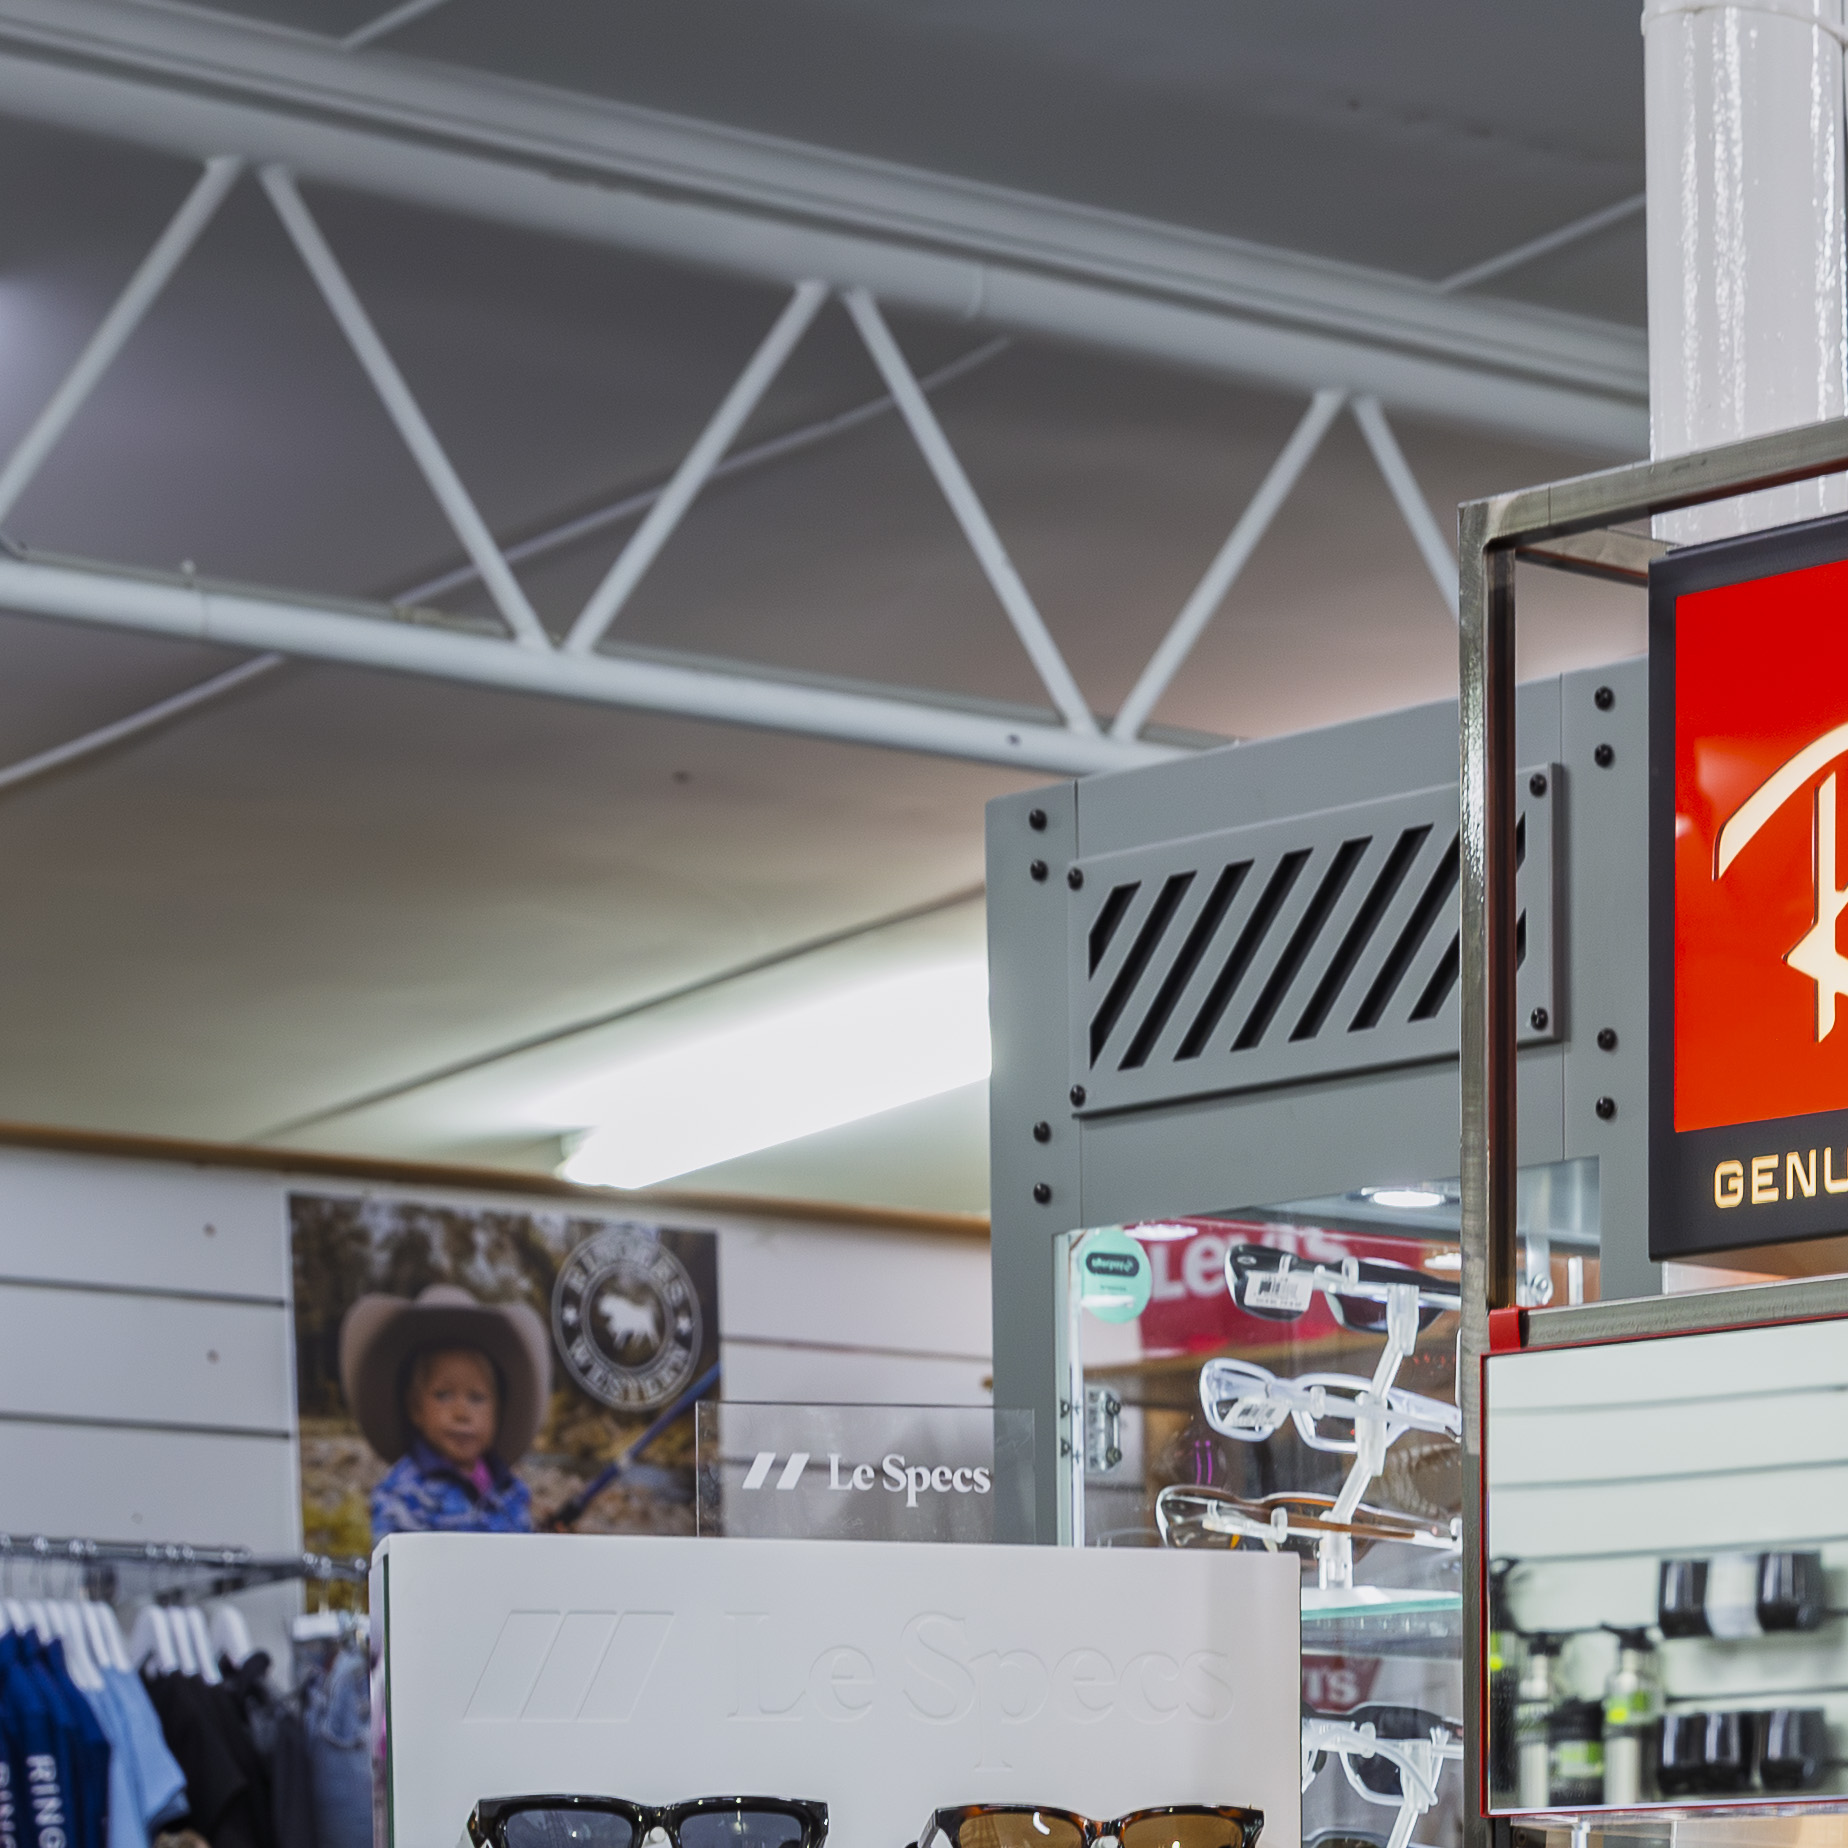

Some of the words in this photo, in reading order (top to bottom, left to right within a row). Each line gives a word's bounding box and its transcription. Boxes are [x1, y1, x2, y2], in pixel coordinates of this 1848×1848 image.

[827, 1454, 874, 1492] Le
[882, 1454, 992, 1508] Specs
[724, 1611, 876, 1724] Le
[900, 1612, 1232, 1773] Specs
